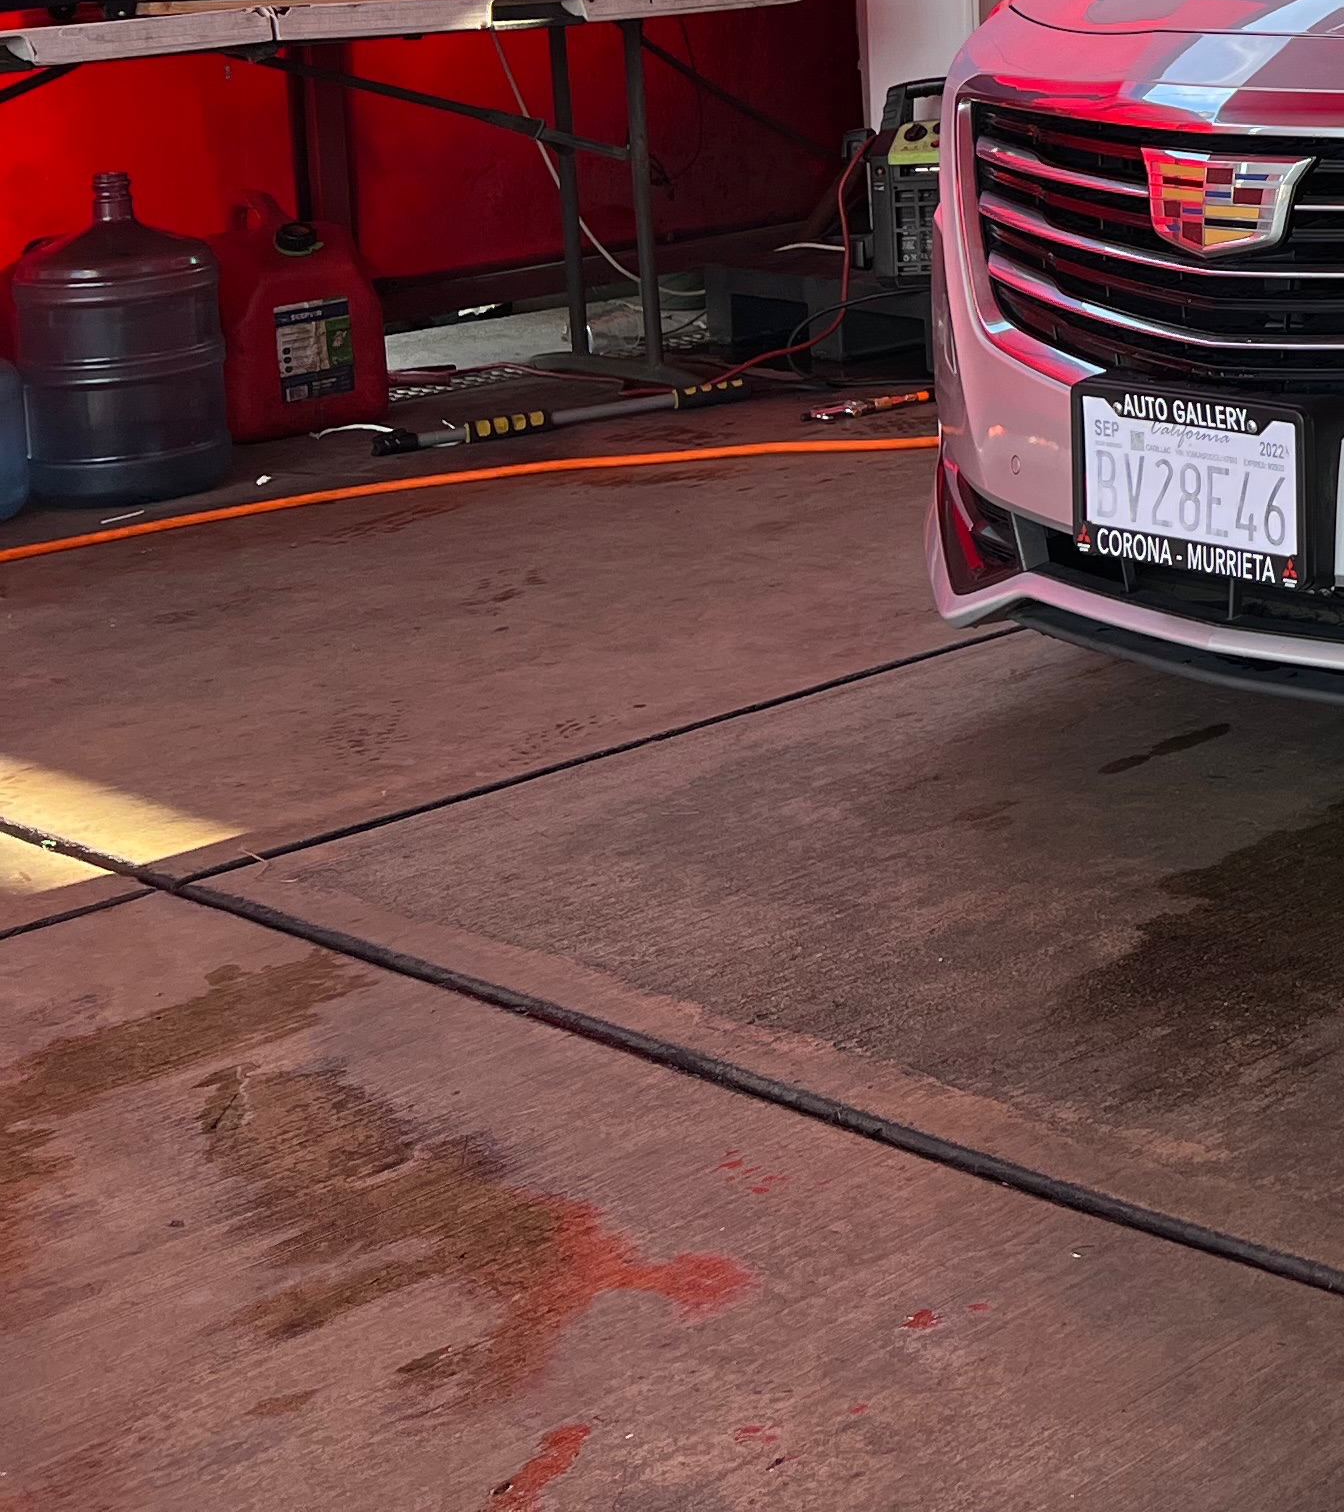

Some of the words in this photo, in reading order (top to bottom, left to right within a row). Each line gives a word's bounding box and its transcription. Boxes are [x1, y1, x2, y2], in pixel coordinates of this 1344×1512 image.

[1094, 419, 1119, 438] SEP
[1123, 393, 1168, 421] AUTO
[1172, 399, 1247, 432] GALLERY
[1150, 421, 1231, 449] California
[1259, 441, 1285, 460] 2022
[1096, 449, 1286, 547] BV28E46
[1097, 527, 1173, 566] CORONA
[1187, 543, 1276, 584] MURRIETA
